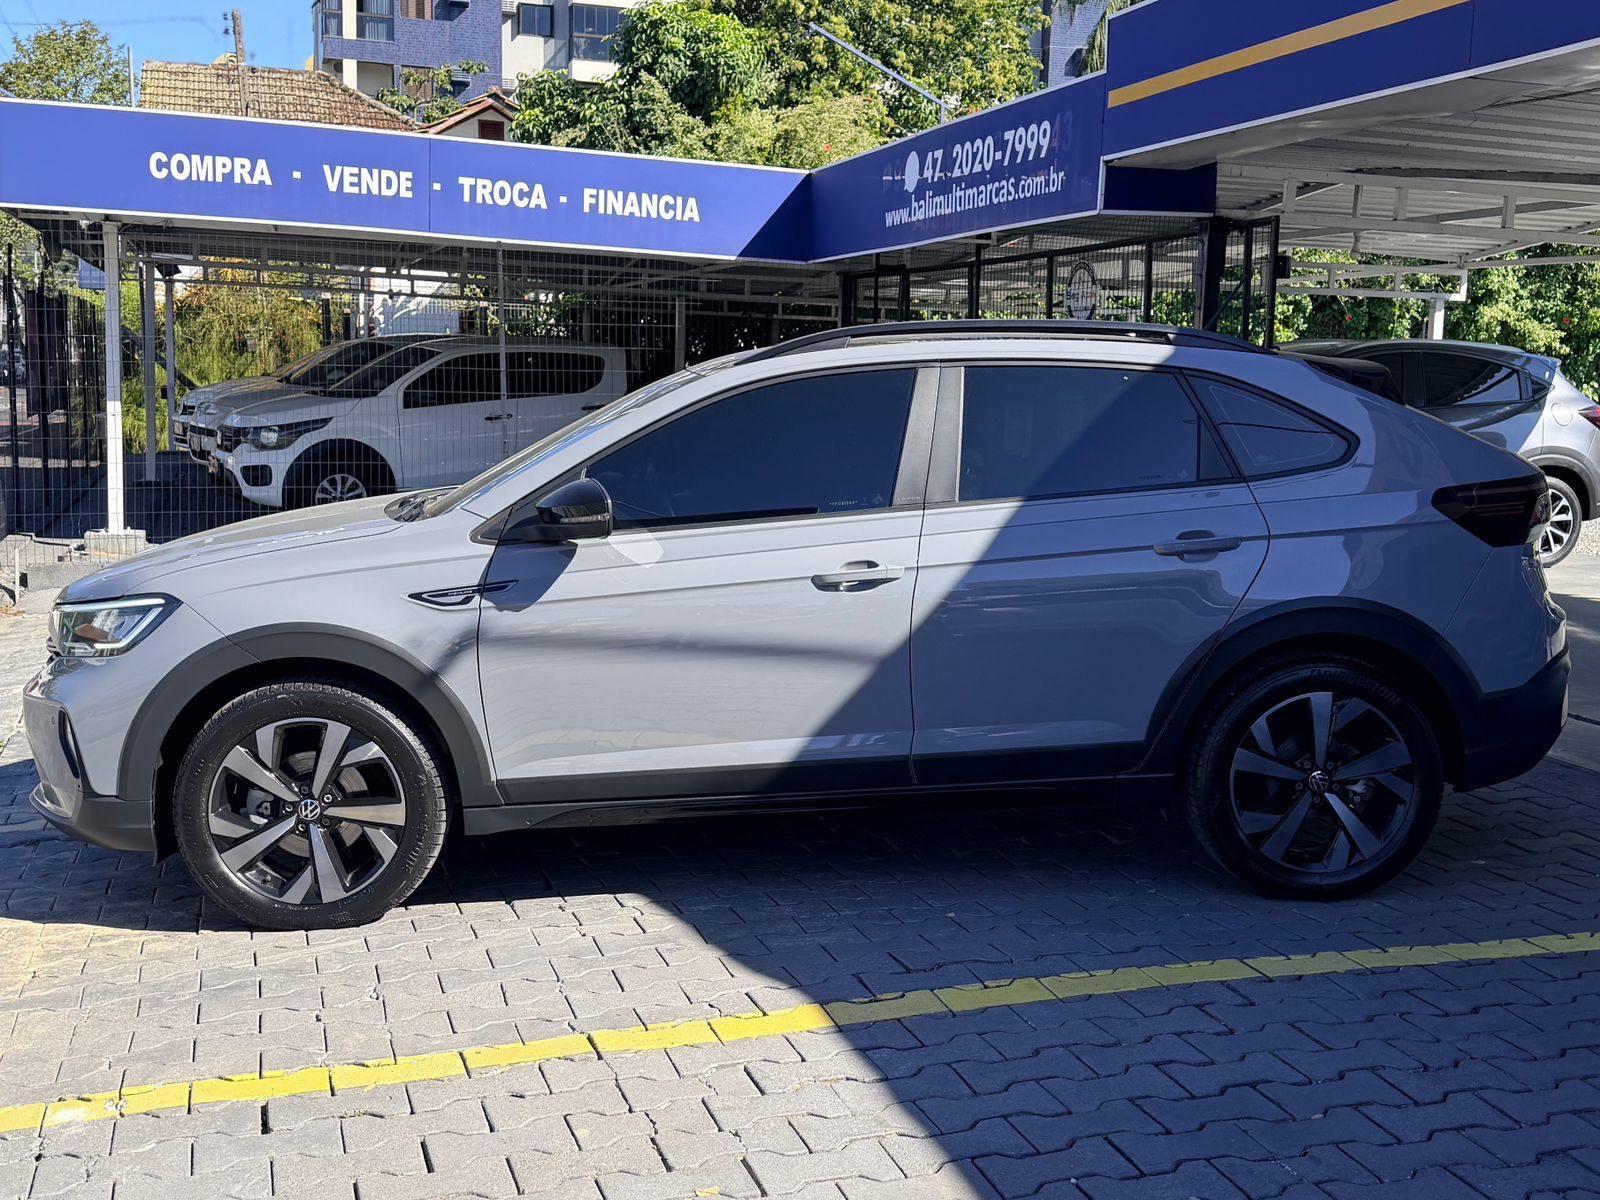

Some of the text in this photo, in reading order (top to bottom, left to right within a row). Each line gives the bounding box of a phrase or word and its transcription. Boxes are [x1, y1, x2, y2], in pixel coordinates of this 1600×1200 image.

[951, 120, 1051, 178] 2020-7999
[149, 151, 701, 222] COMPRA VENDE TROCA FINANCIA
[885, 165, 1065, 228] www.balimultimarcas.com.br
